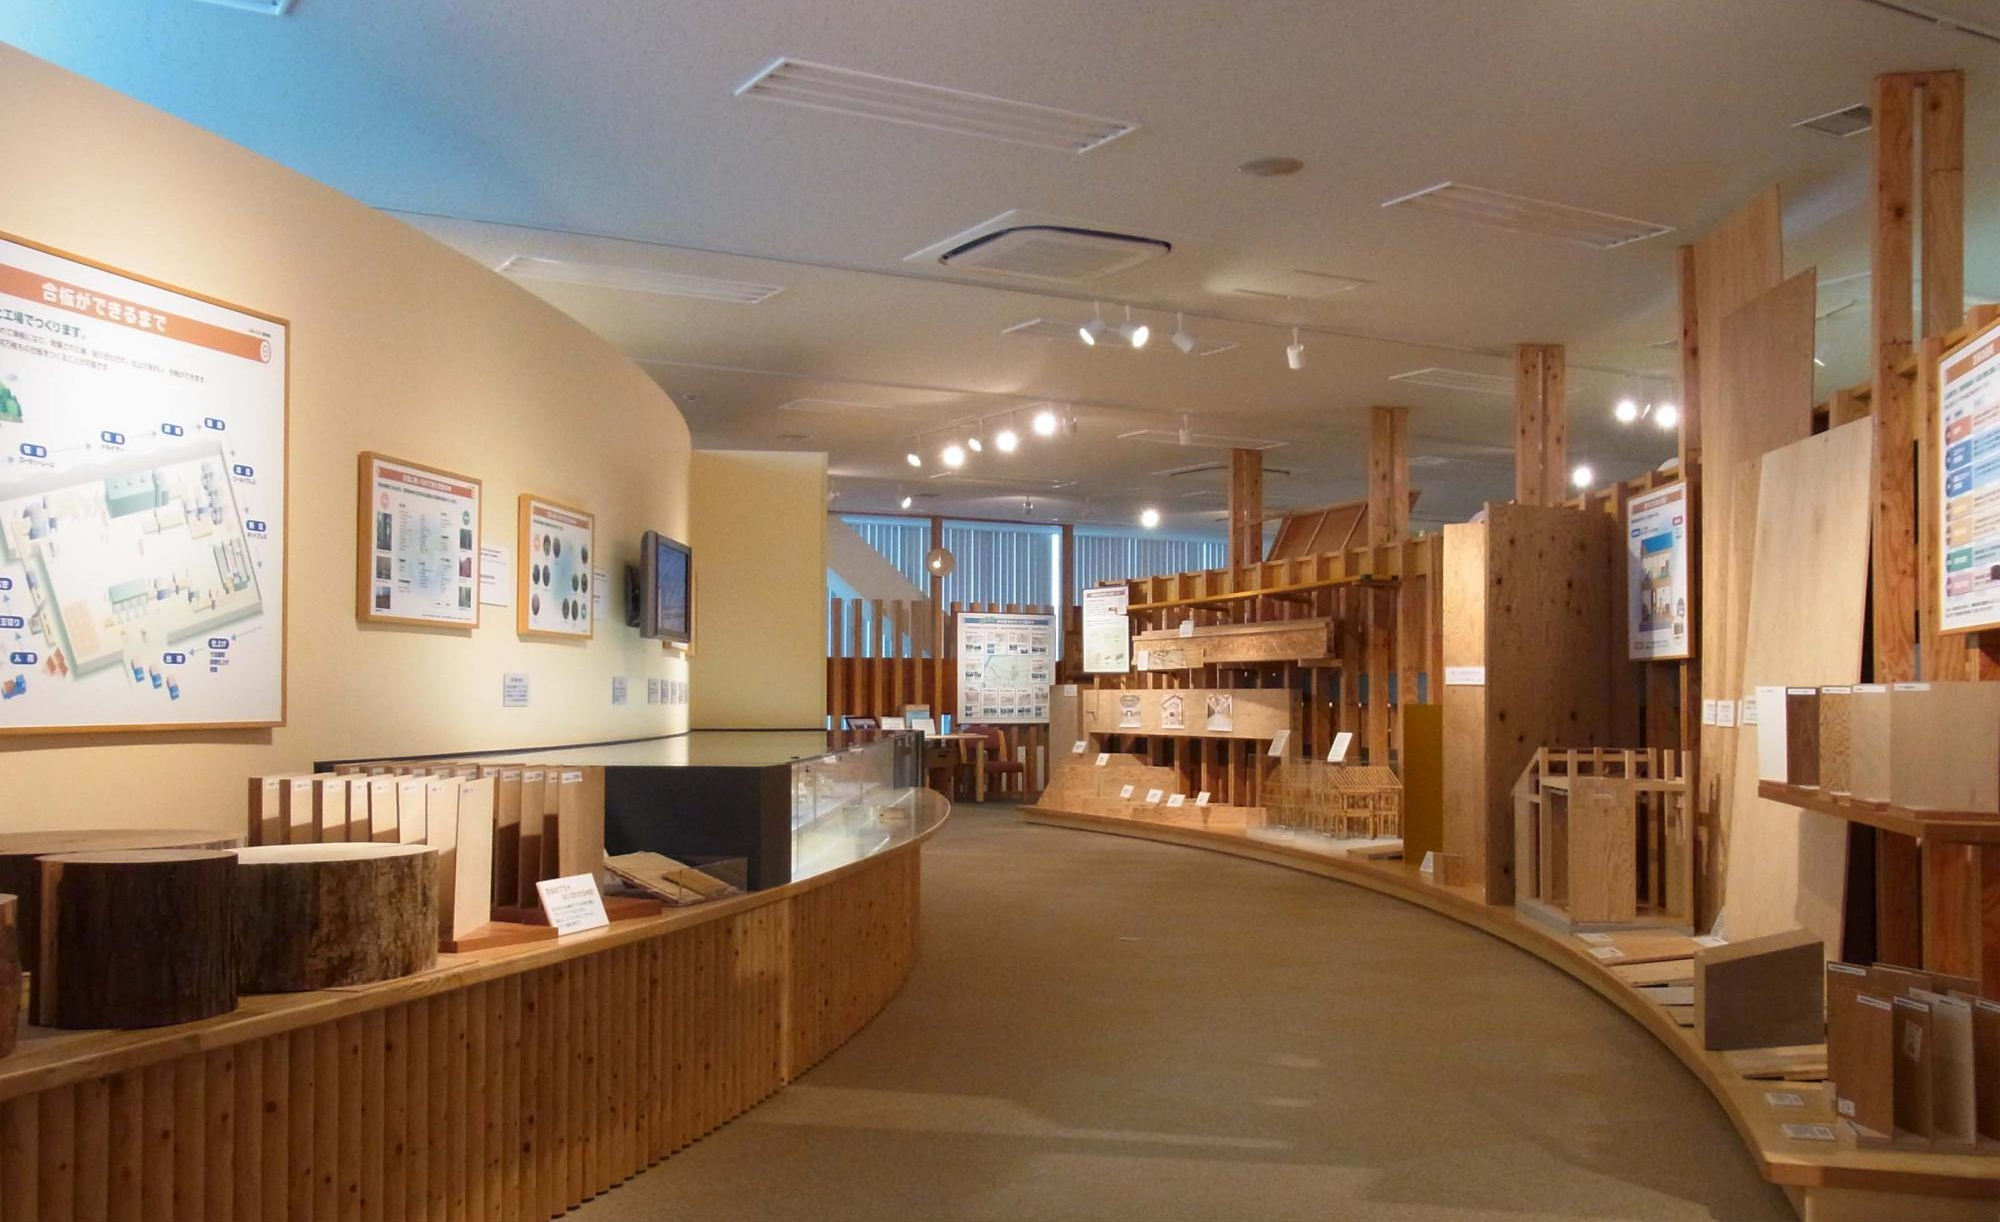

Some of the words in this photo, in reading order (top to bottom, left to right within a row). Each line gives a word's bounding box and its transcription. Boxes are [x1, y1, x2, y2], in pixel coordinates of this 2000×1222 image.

[41, 282, 168, 333] 合板ができるまで
